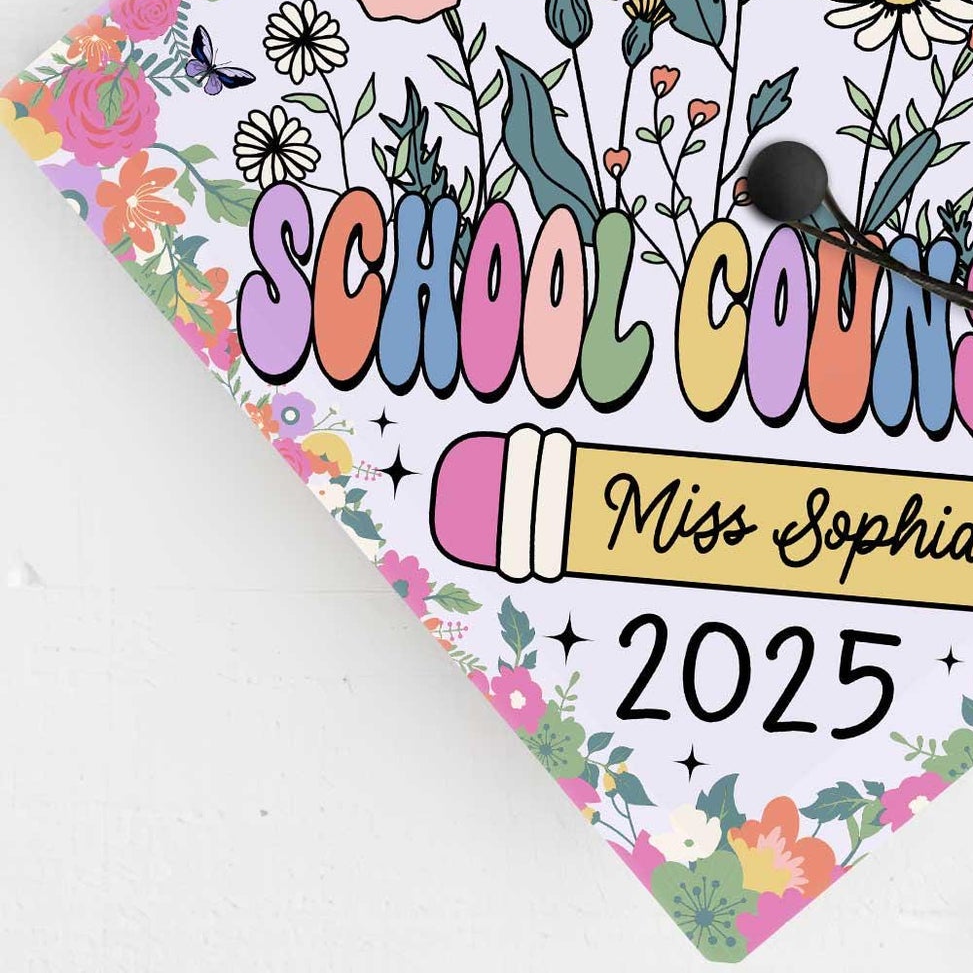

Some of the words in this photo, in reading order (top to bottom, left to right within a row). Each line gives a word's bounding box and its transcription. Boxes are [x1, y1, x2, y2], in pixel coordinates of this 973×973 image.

[236, 180, 654, 414] SCHOOL
[604, 473, 758, 554] Miss
[616, 613, 902, 739] 2025
